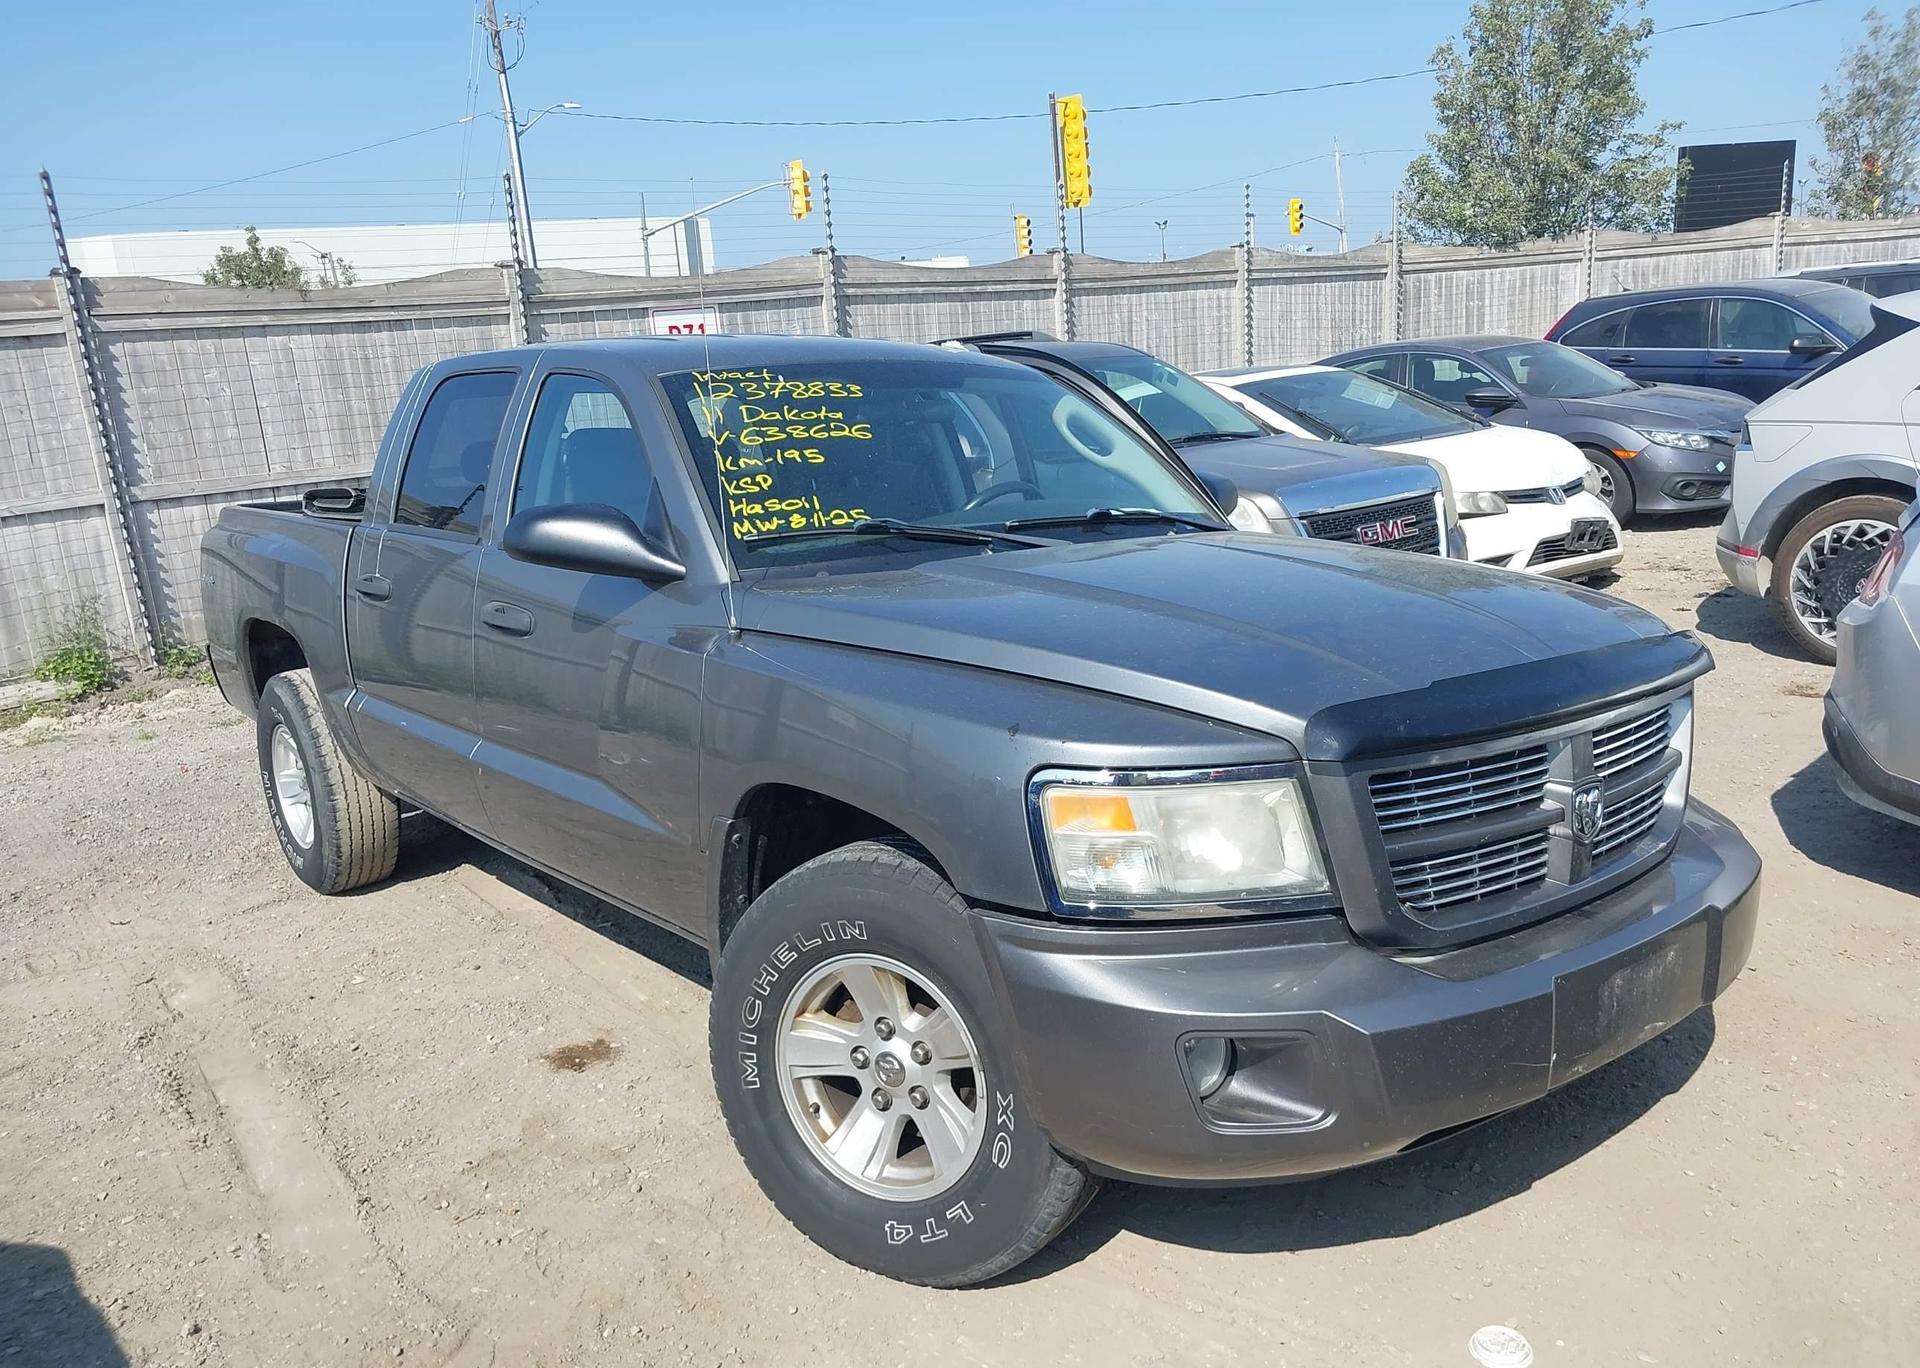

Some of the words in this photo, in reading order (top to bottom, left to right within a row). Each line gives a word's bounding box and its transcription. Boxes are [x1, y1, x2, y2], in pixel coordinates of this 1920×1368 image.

[739, 405, 844, 423] Dakota
[1358, 515, 1419, 545] GMC
[738, 919, 869, 1089] MICHELIN
[991, 1090, 1016, 1170] XC
